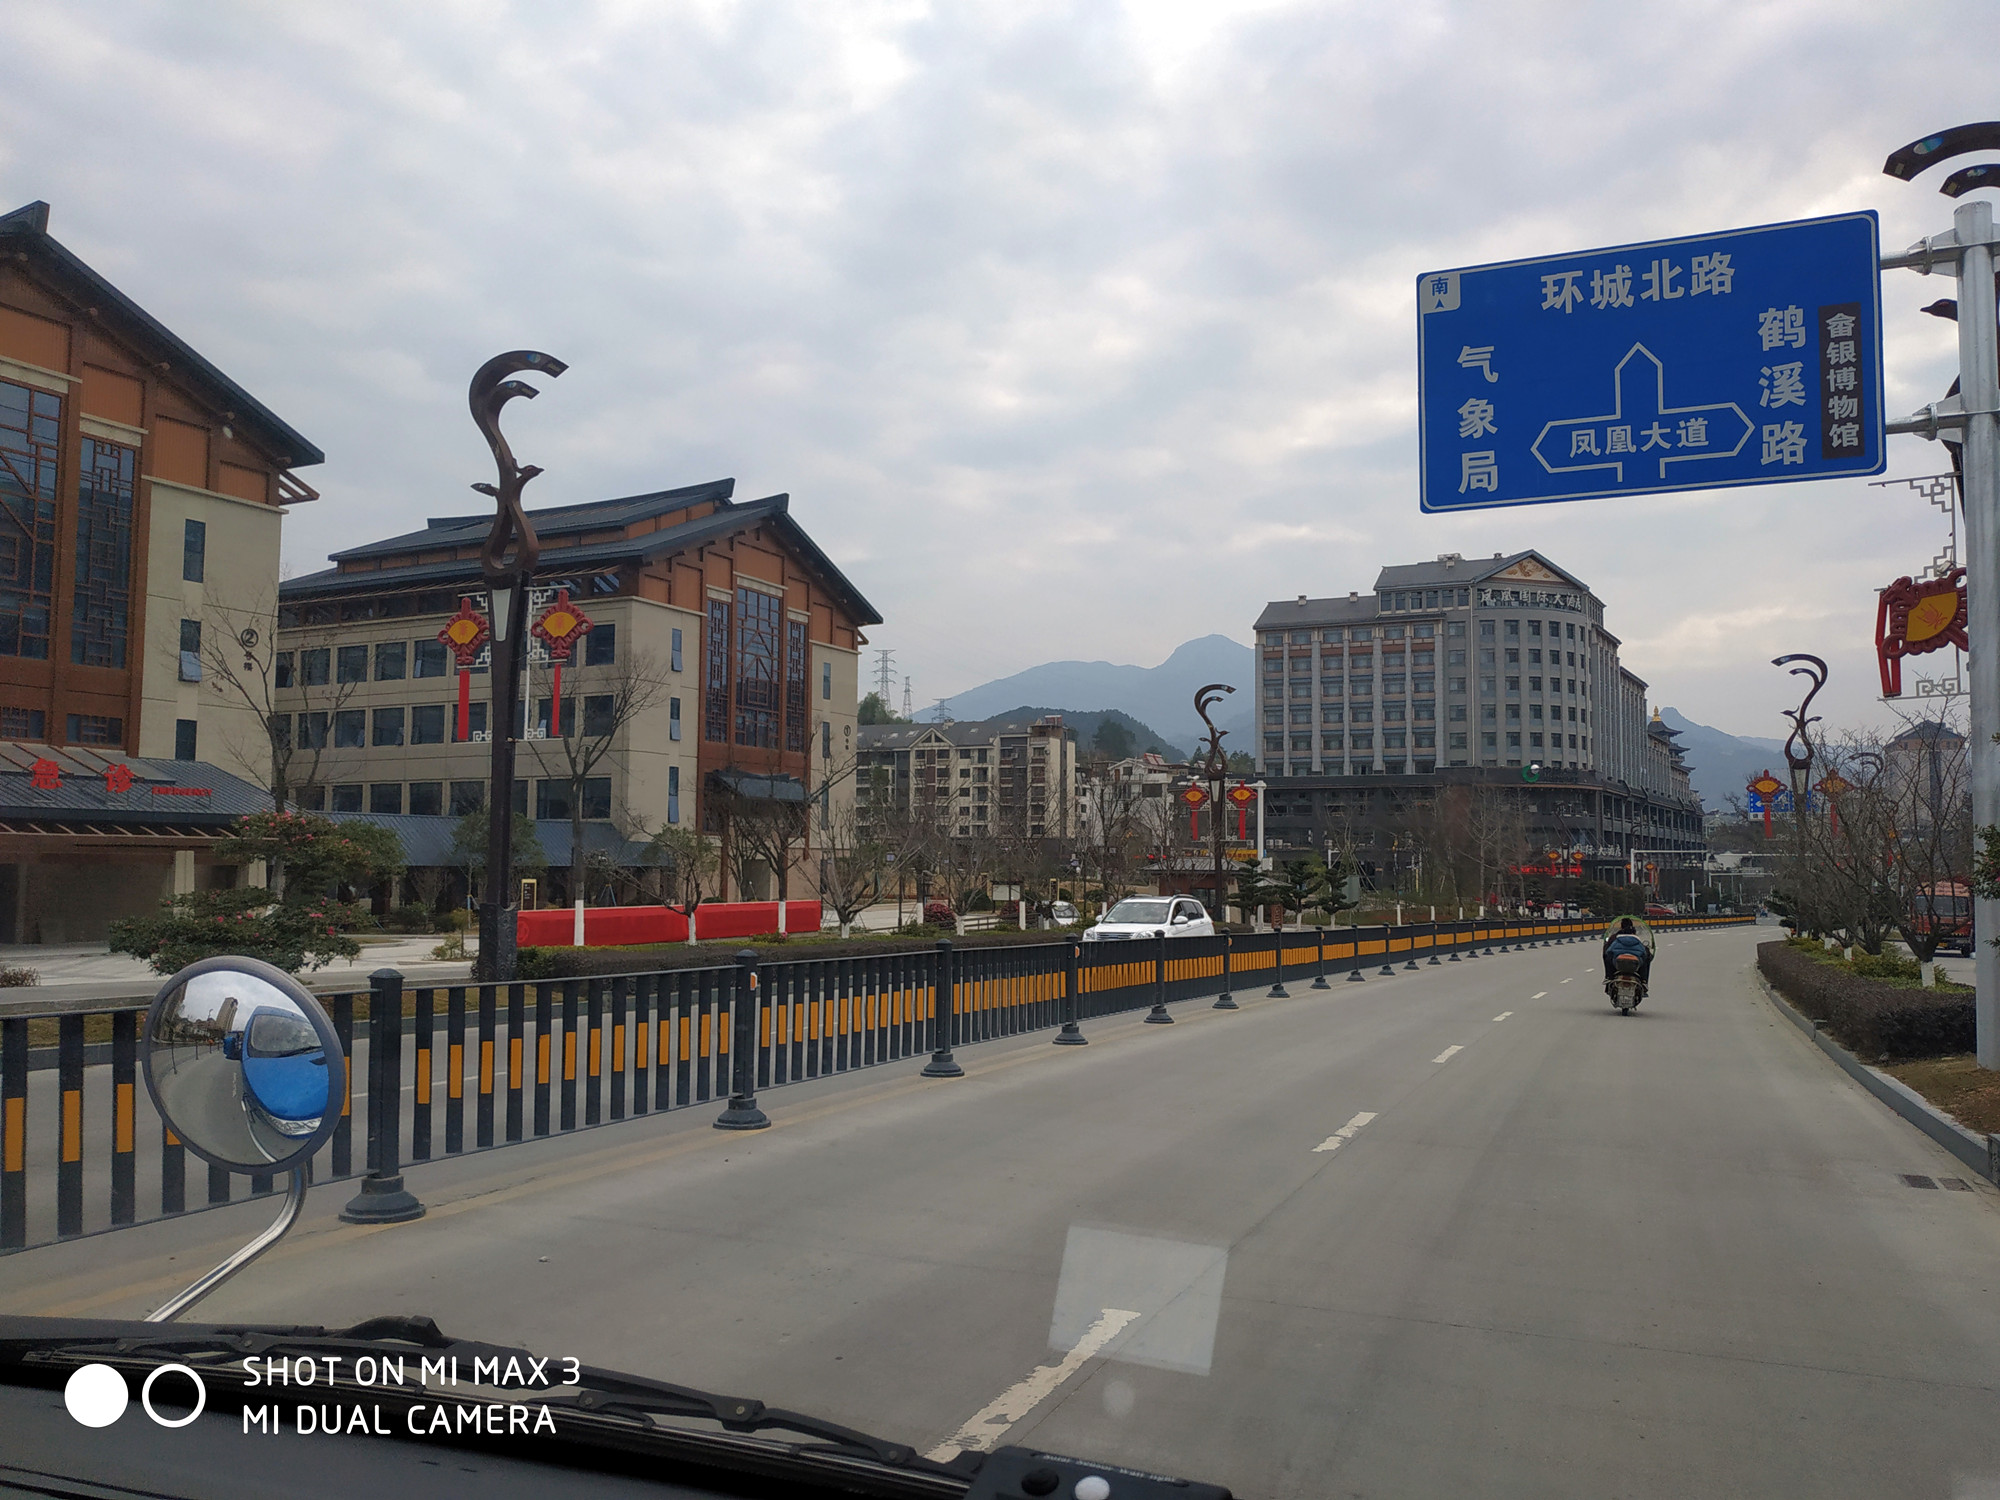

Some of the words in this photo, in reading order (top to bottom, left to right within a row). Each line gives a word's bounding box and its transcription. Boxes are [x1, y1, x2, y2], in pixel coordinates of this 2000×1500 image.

[1430, 276, 1450, 297] 南
[1540, 251, 1736, 314] 环城北路
[1757, 304, 1808, 466] 鹤溪路
[1825, 312, 1860, 449] 畲银博物馆
[1456, 345, 1499, 495] 气象局
[1569, 416, 1710, 458] 凤凰大道
[151, 786, 213, 797] EMERGENCY
